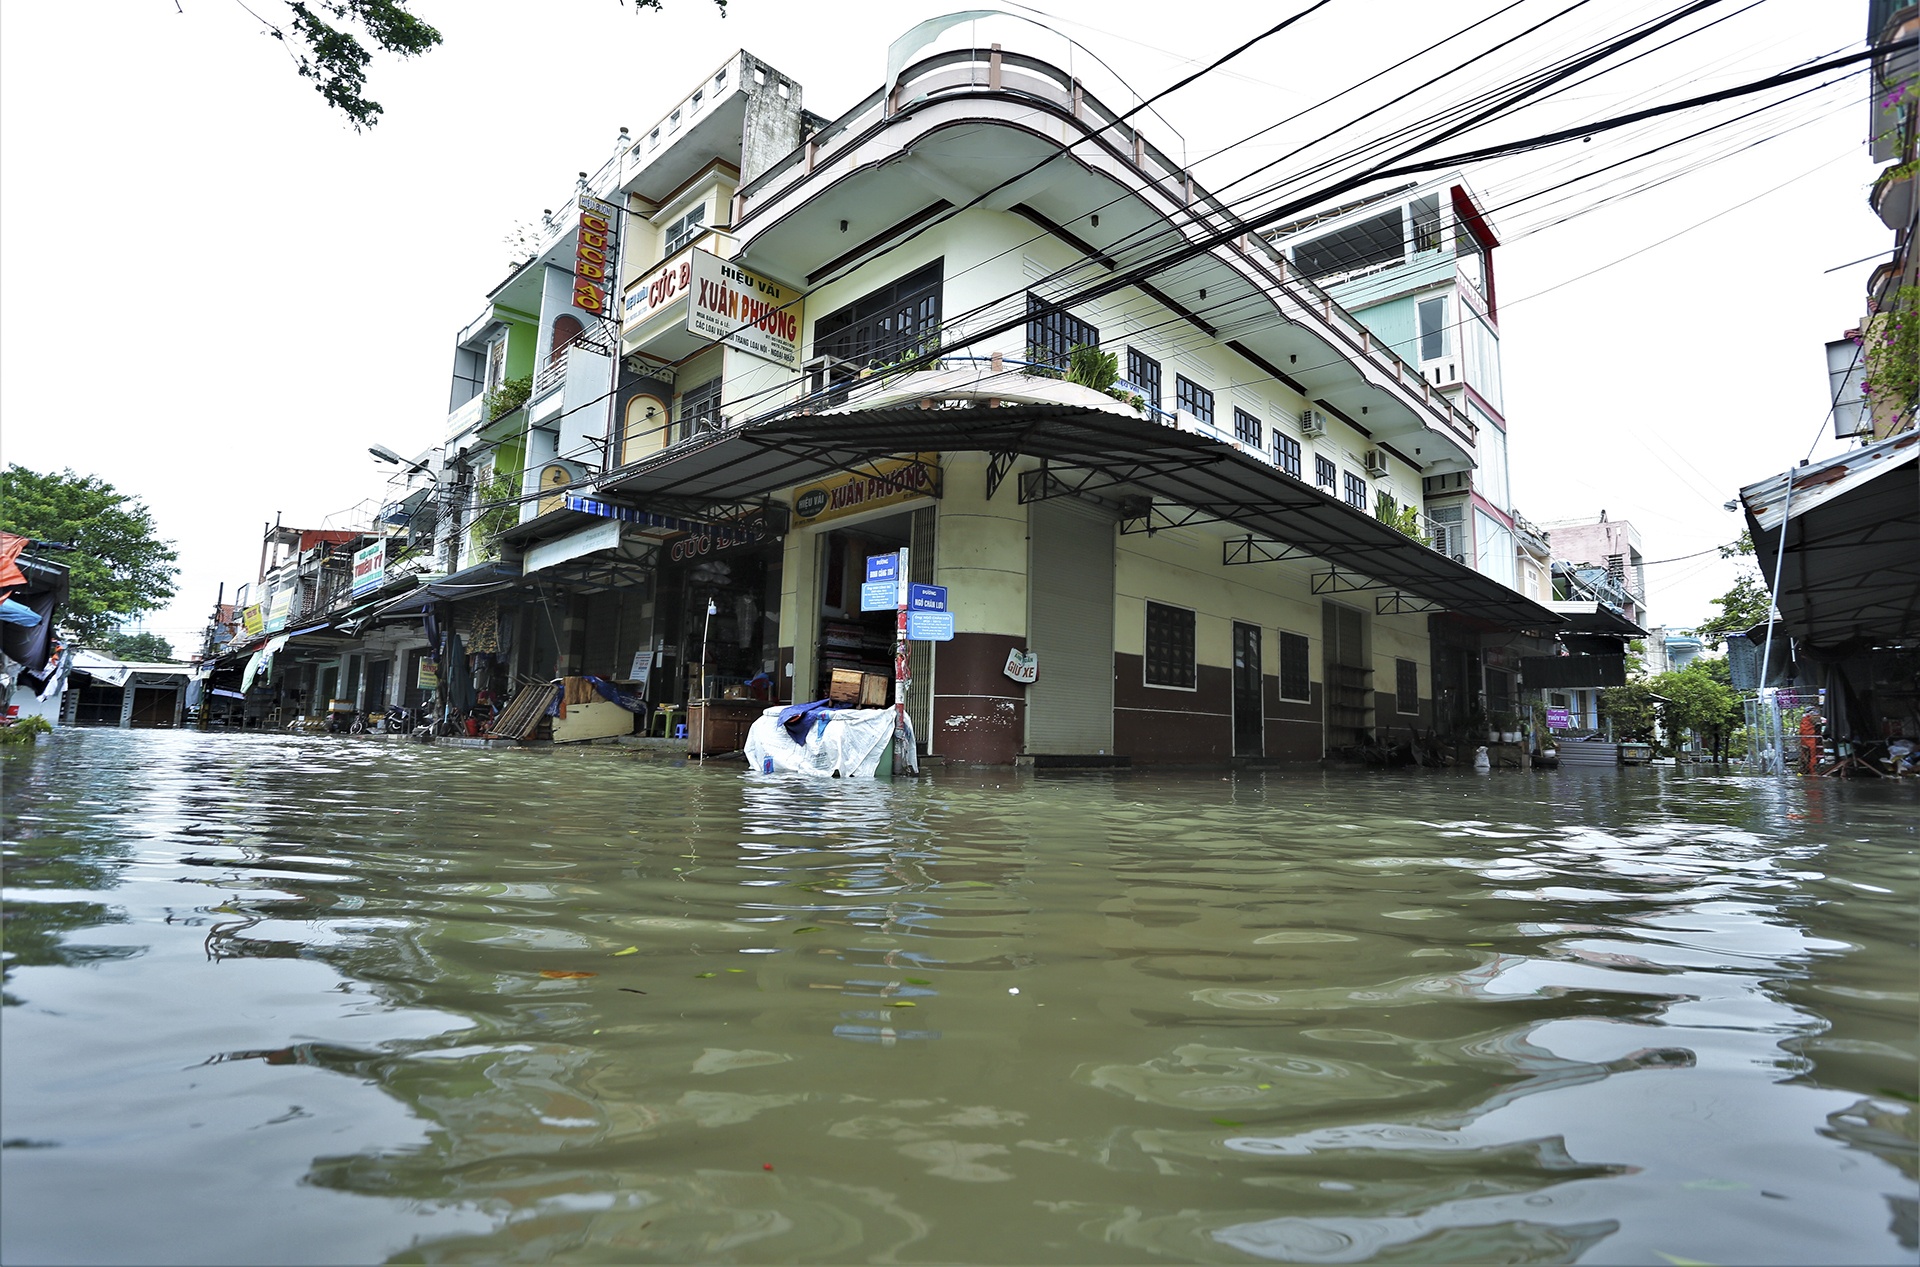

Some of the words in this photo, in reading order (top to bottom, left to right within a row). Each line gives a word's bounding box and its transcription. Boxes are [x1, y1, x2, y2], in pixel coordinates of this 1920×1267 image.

[648, 268, 676, 309] CÚC
[721, 265, 754, 287] HIỆU
[758, 280, 780, 298] VẢI
[698, 277, 739, 320] XUÂN
[741, 294, 797, 342] PHƯƠNG
[695, 319, 705, 330] CÁC
[705, 324, 716, 335] LOẠI
[735, 334, 750, 347] TRANG
[830, 477, 864, 511] XUÂN
[1023, 667, 1034, 677] XE
